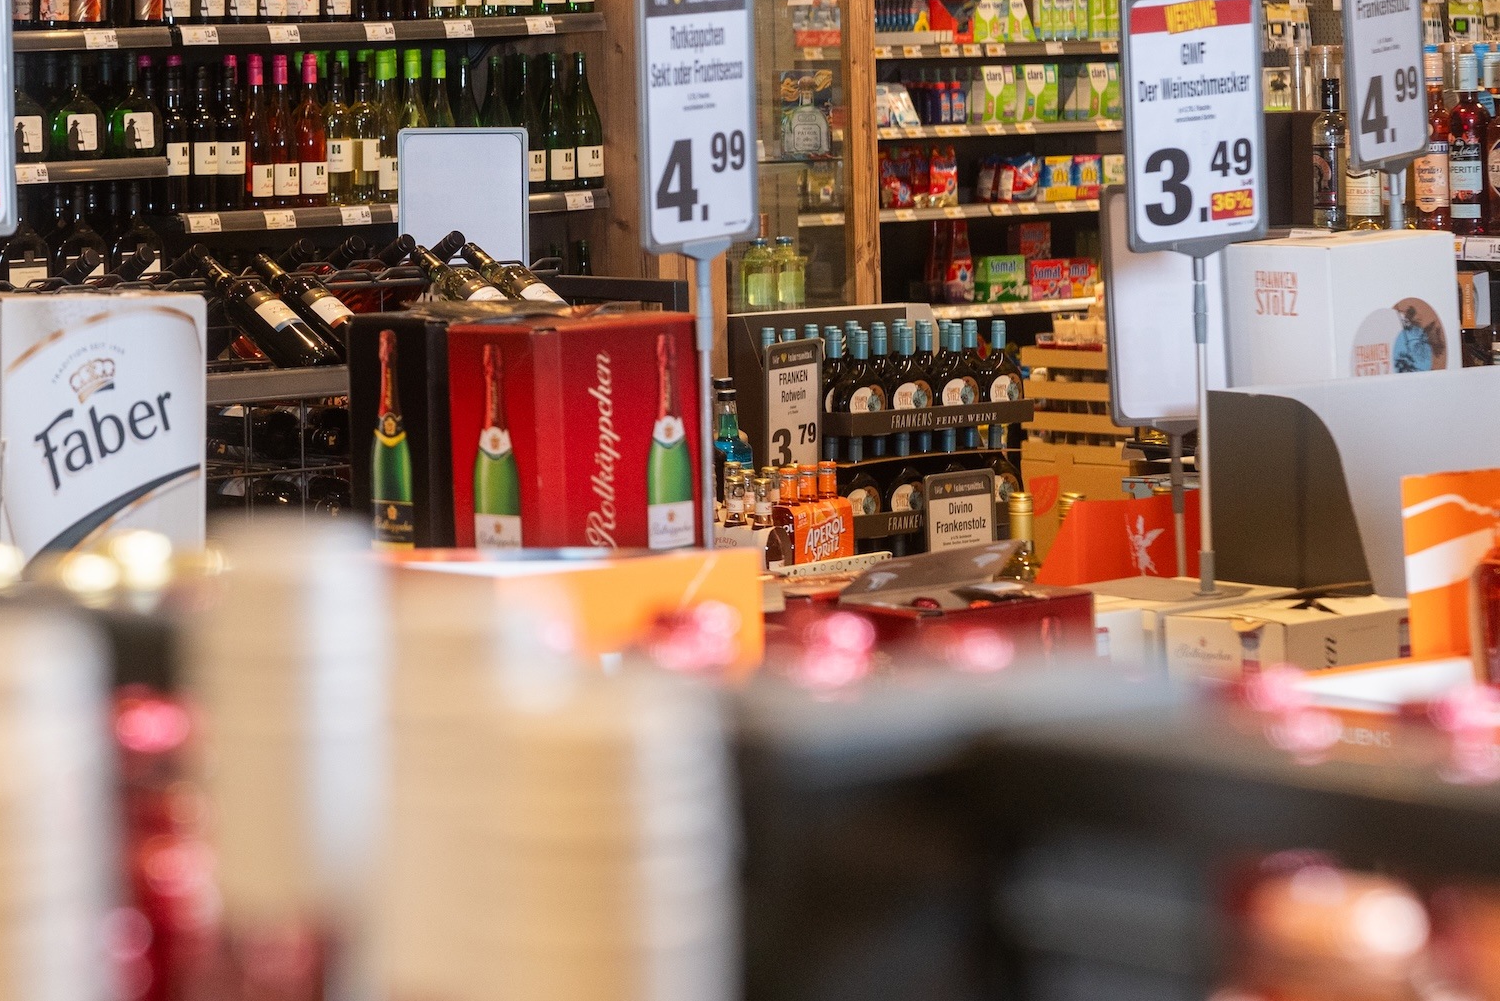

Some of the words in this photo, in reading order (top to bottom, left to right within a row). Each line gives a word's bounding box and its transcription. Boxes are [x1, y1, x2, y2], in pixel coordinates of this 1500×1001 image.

[670, 24, 725, 53] Rotkäppchen
[1180, 42, 1207, 65] GWF
[651, 63, 671, 87] Sekt
[673, 62, 693, 86] oder
[694, 58, 743, 83] Fruchtsecco
[1138, 80, 1158, 102] Der
[1160, 70, 1251, 99] Weinschmecker
[1360, 74, 1397, 145] 4.
[1395, 65, 1419, 103] 99
[656, 138, 710, 222] 4.
[711, 129, 746, 174] 99
[1144, 147, 1208, 227] 3.
[1210, 137, 1253, 178] 49
[1212, 189, 1254, 212] 36%
[990, 259, 1017, 273] Somat
[1033, 264, 1061, 280] Somat
[1254, 270, 1298, 288] FRANKEN
[1254, 288, 1299, 317] STOLZ
[779, 369, 808, 386] FRANKEN
[781, 388, 807, 403] Rotwein
[891, 412, 933, 429] FRANKENS
[936, 415, 964, 426] FEINE
[967, 412, 998, 422] WEINE
[35, 391, 172, 490] Faber
[798, 422, 817, 445] 79
[948, 502, 973, 515] Divino
[805, 516, 846, 554] APEROL
[936, 516, 986, 534] Frankenstolz
[812, 536, 840, 562] SPRITZ
